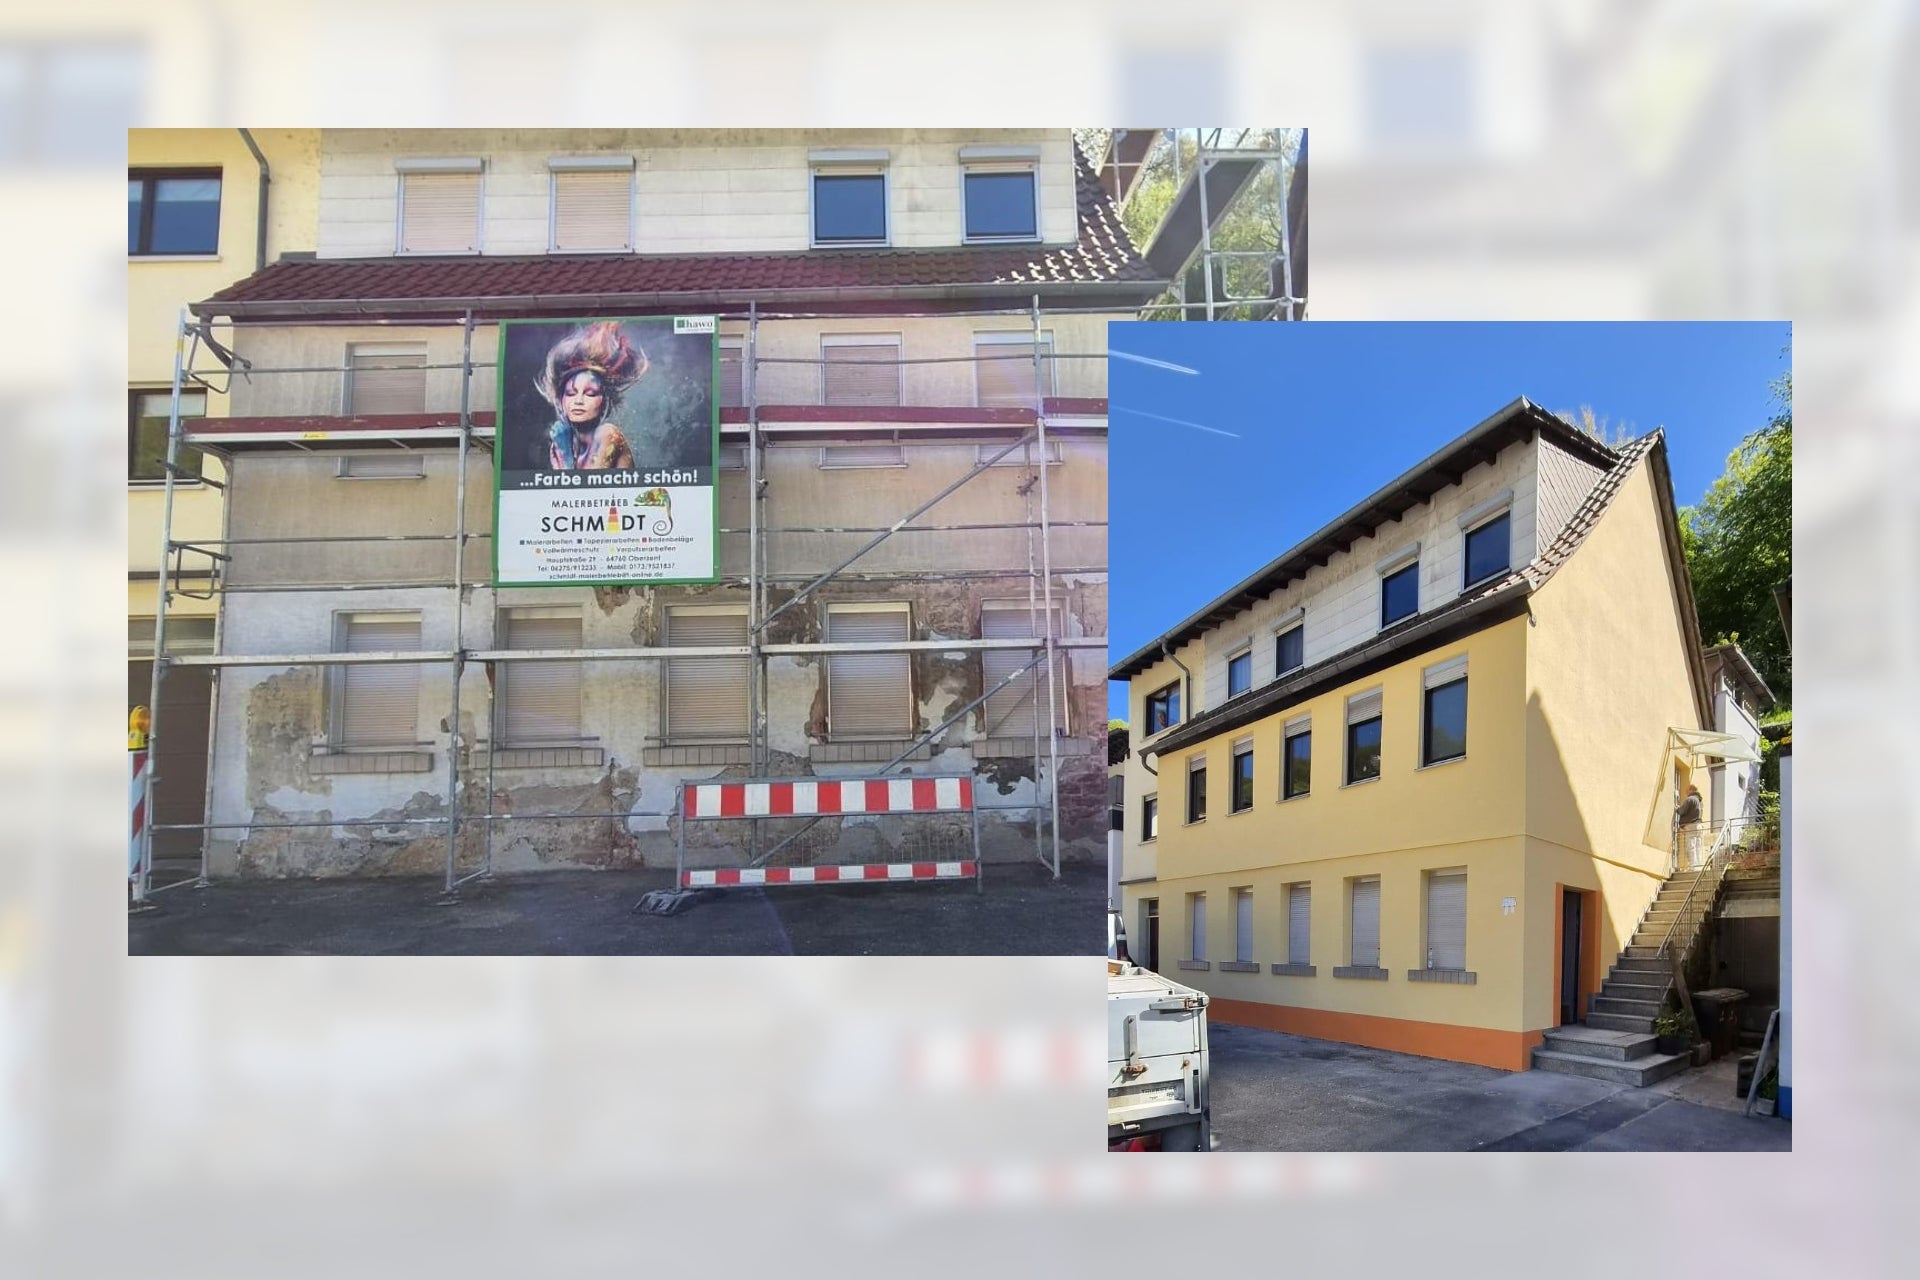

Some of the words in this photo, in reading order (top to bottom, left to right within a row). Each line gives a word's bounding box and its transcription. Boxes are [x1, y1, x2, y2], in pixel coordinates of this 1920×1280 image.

[520, 473, 582, 487] ...Farbe
[587, 471, 639, 485] macht
[644, 469, 698, 484] schön!
[584, 537, 640, 545] Tapezierarbeiten
